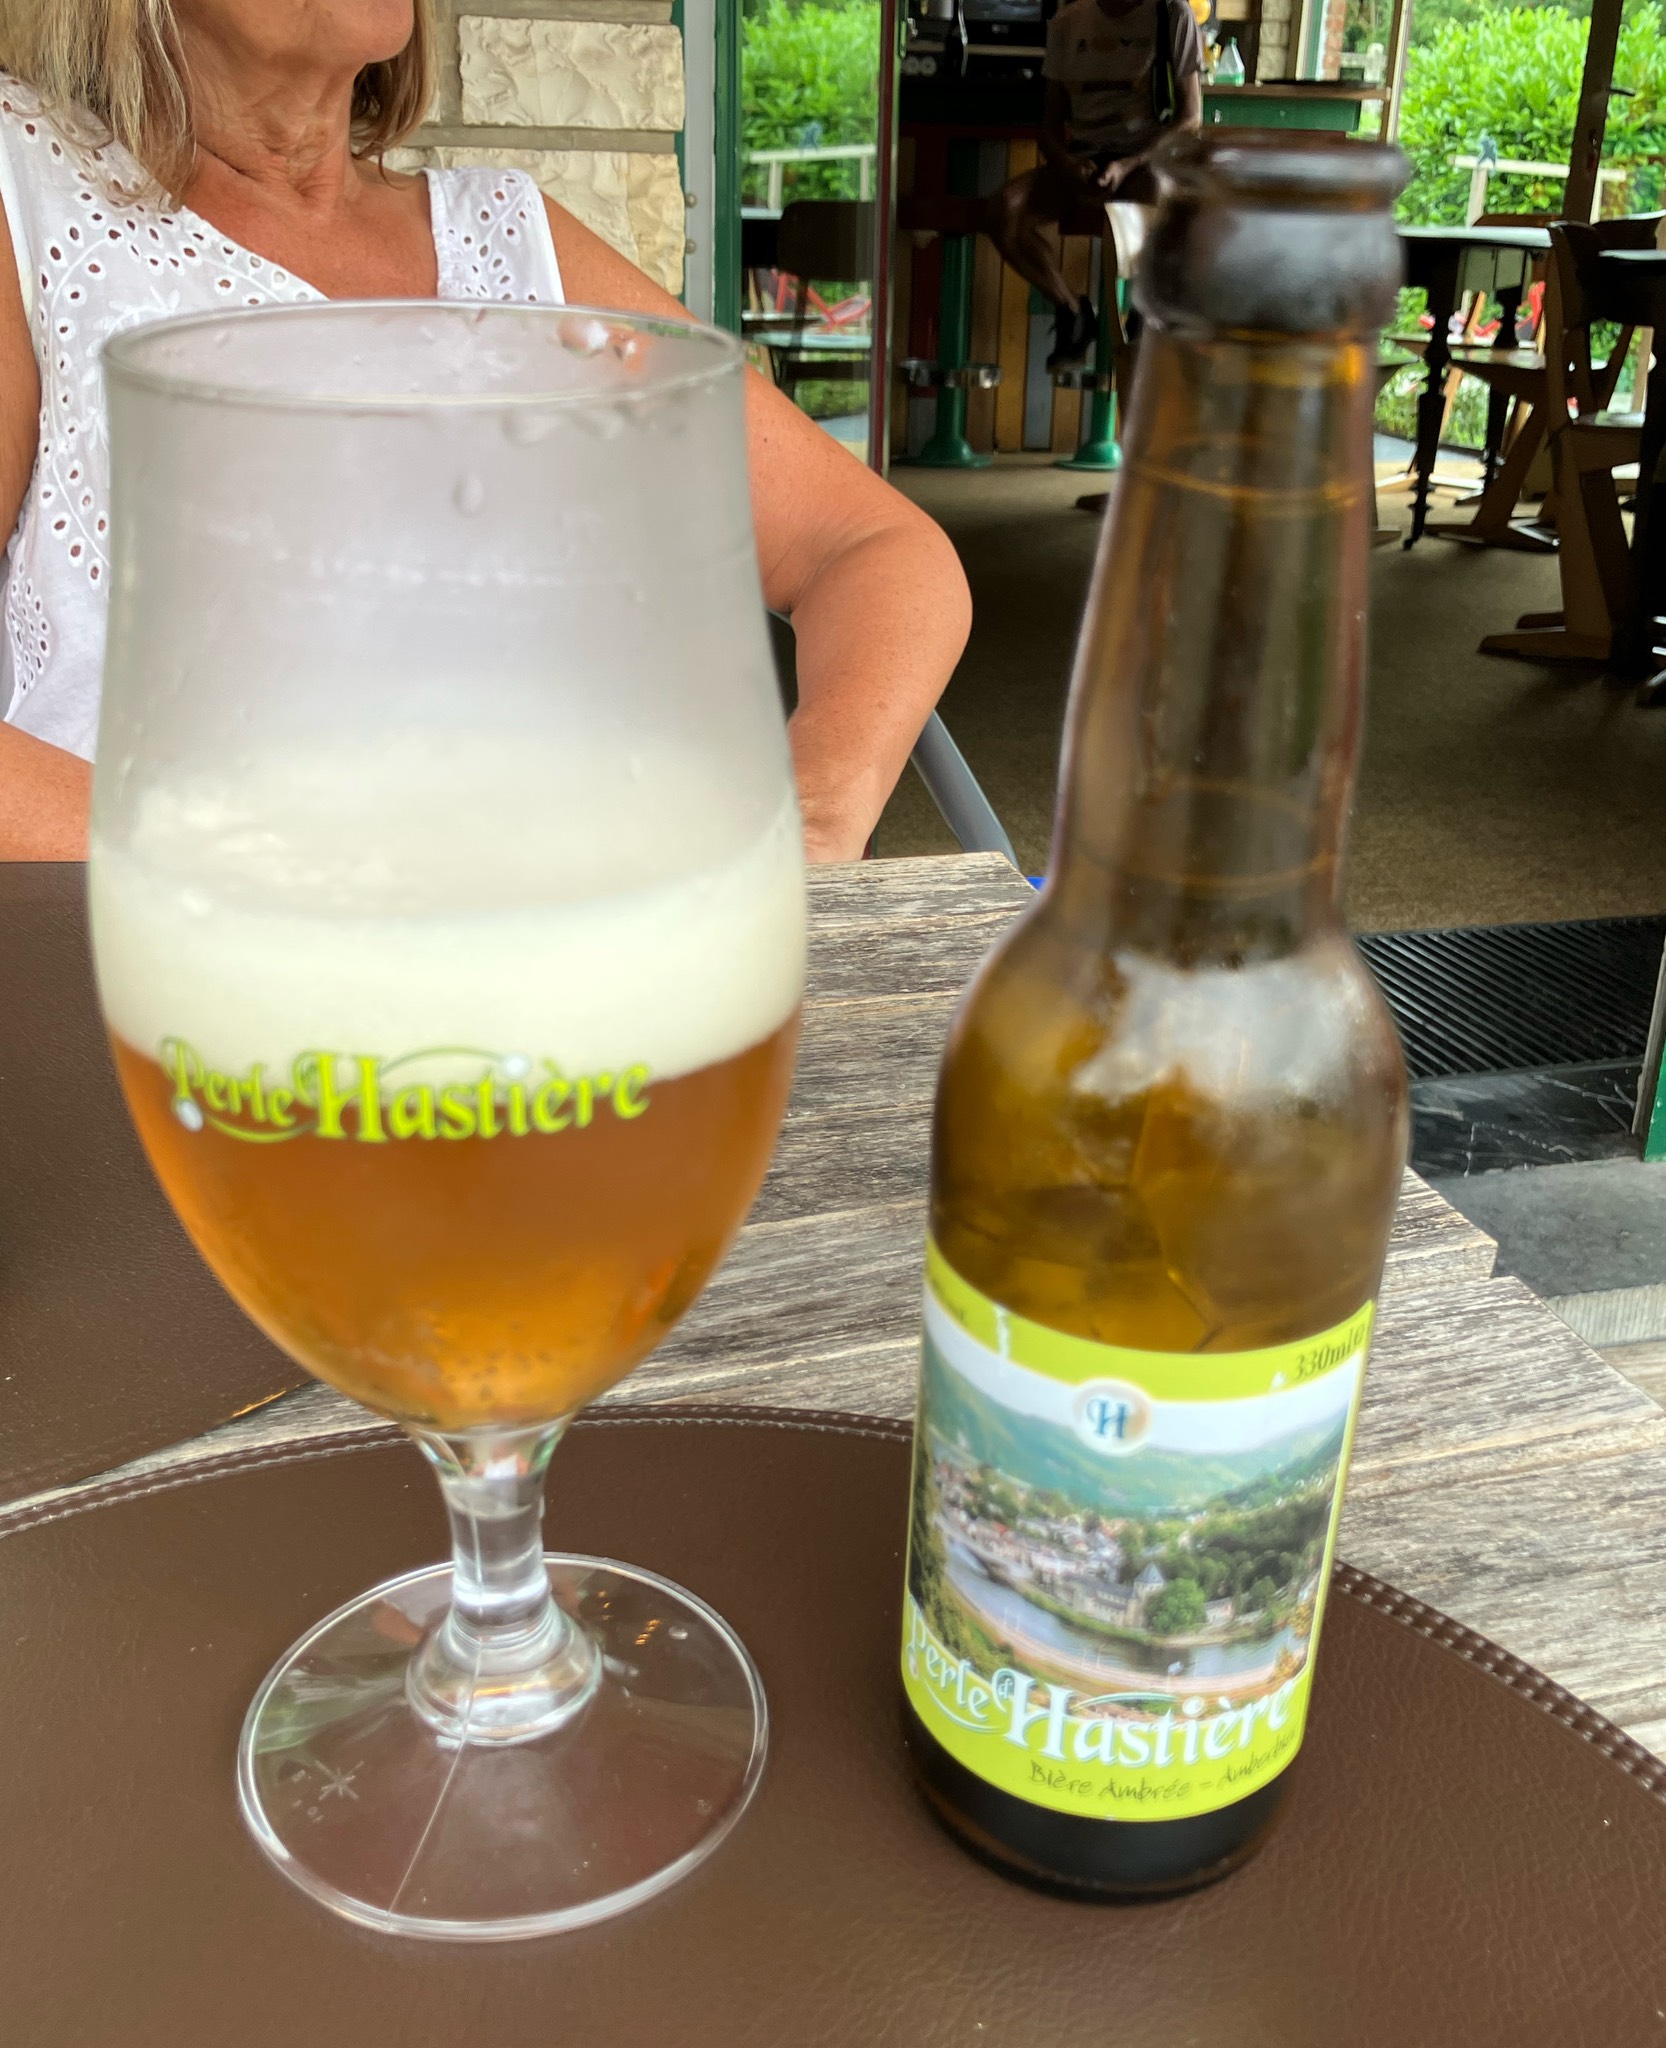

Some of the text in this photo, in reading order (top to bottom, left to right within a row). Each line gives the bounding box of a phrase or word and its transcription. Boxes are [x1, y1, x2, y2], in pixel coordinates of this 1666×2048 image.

[160, 1036, 298, 1132] Perle
[907, 1595, 989, 1721] Perle
[1028, 1760, 1092, 1794] Bière
[1098, 1777, 1191, 1803] Ambrée
